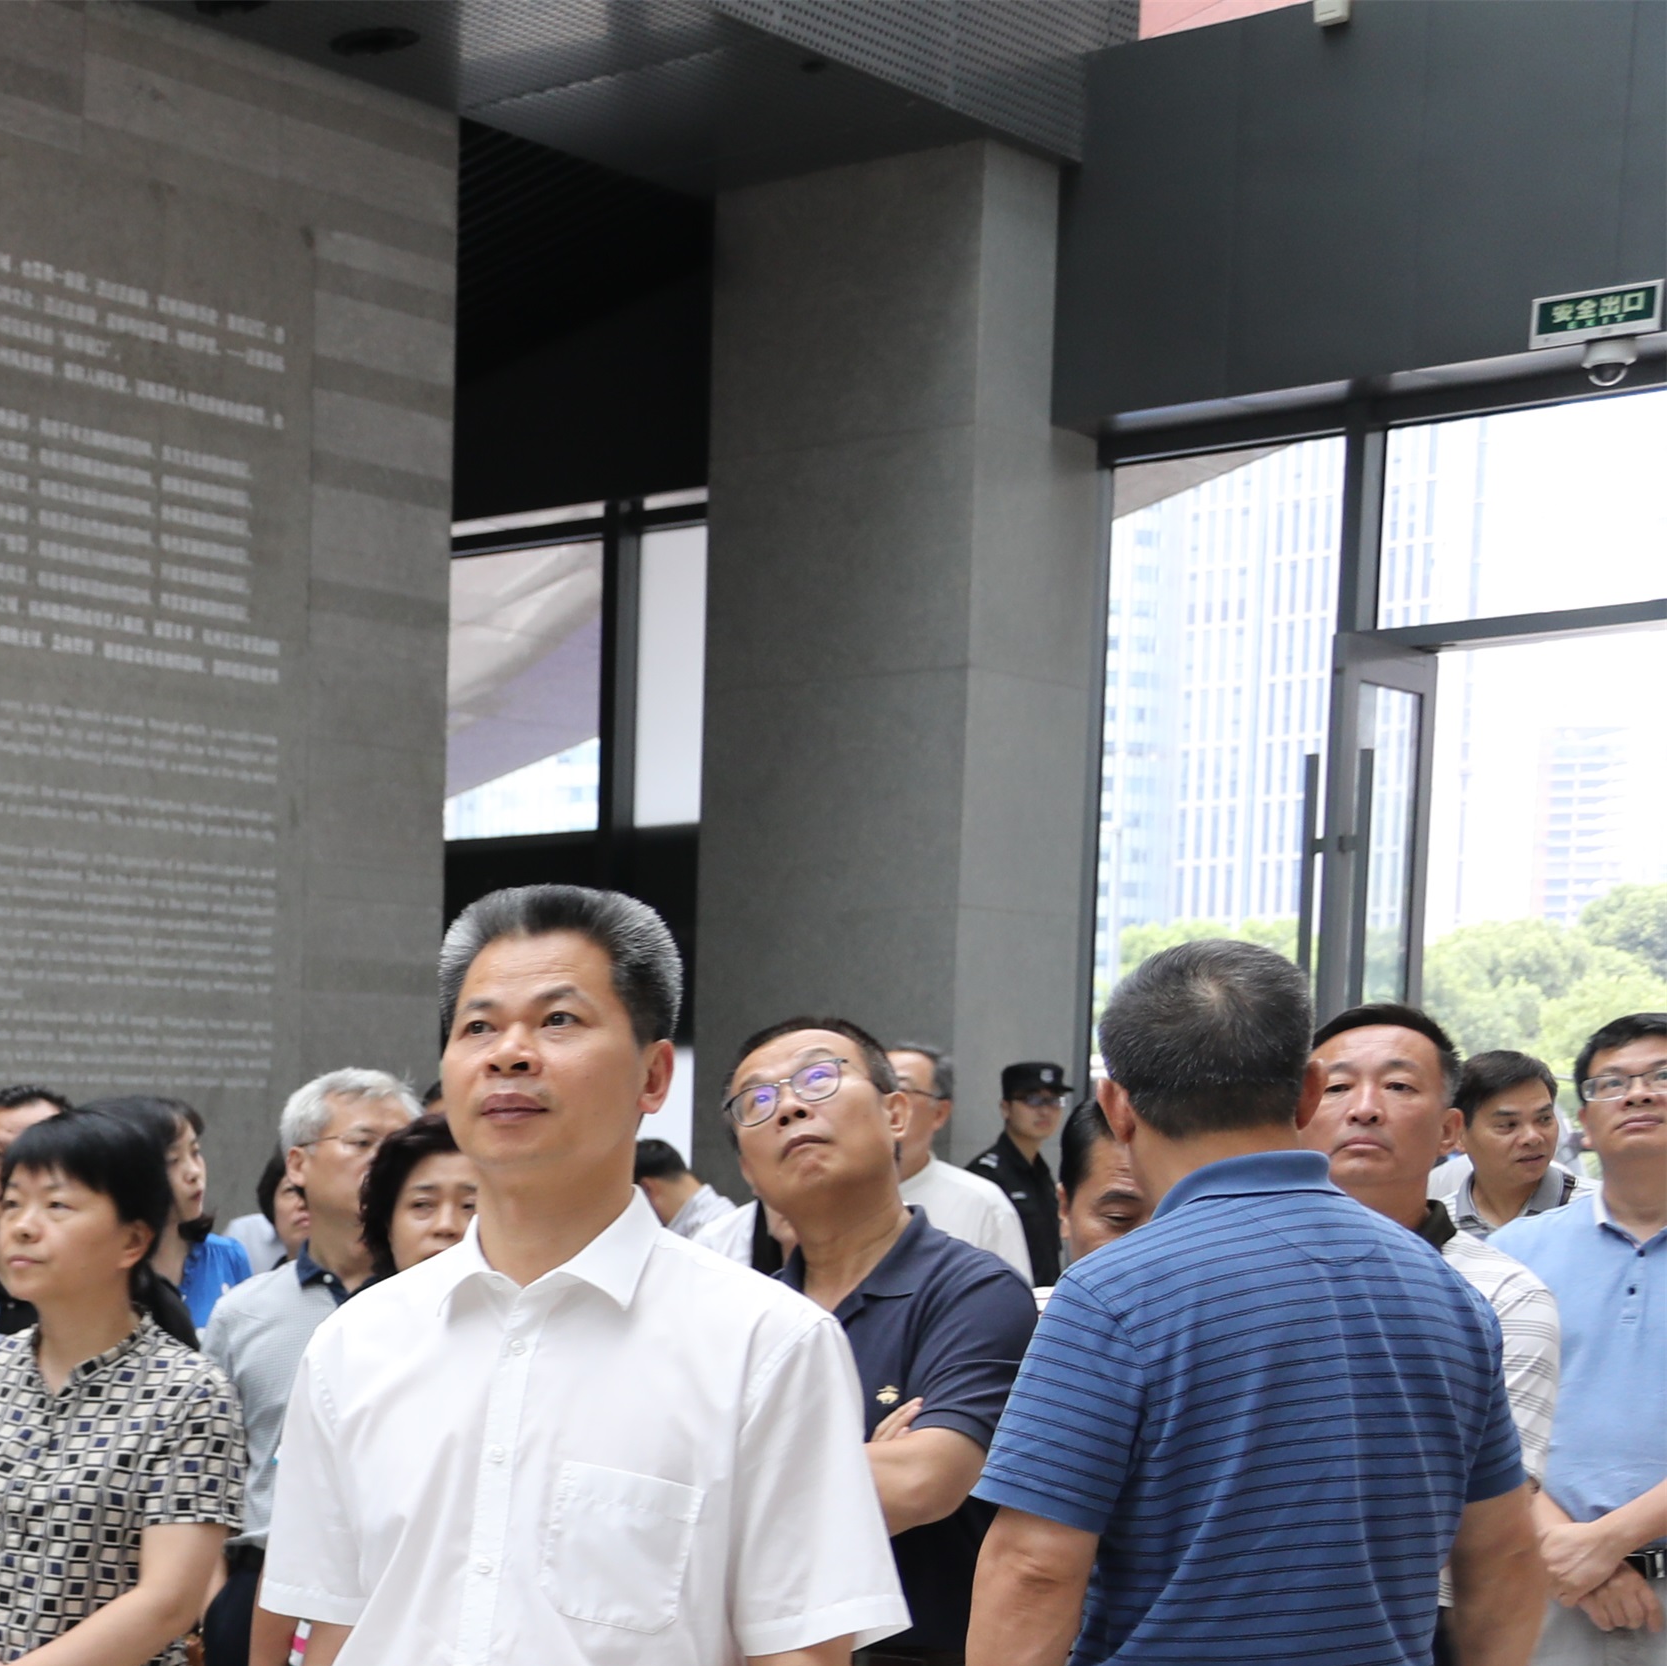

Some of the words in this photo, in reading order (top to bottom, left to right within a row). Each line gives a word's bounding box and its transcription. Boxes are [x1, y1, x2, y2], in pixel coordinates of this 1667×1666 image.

[1552, 292, 1645, 323] 安全出口
[1568, 315, 1626, 329] EXIT
